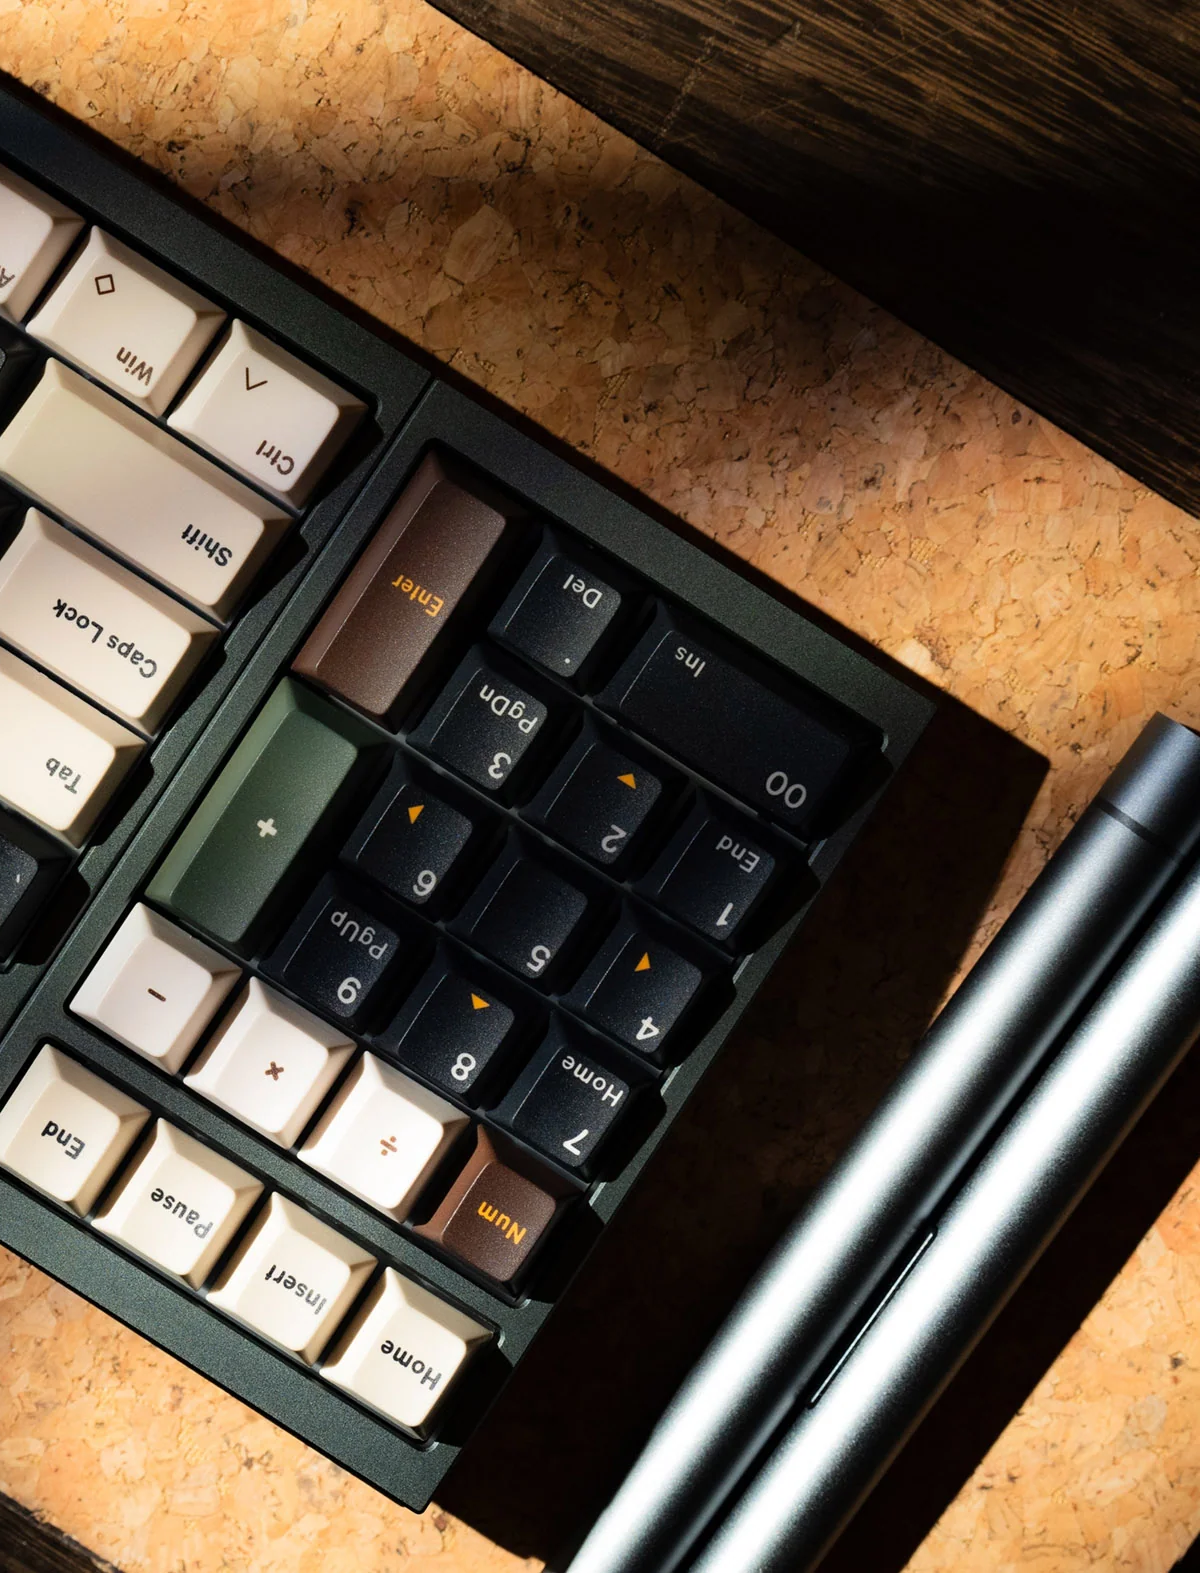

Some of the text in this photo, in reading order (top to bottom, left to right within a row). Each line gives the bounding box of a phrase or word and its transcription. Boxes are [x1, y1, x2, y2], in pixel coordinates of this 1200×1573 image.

[117, 347, 153, 385] Win
[256, 440, 294, 475] Ctrl
[182, 524, 232, 566] Shift
[392, 573, 444, 618] Enter
[563, 575, 602, 608] Del
[53, 599, 157, 678] Caps Lock
[675, 647, 705, 677] Ins
[480, 685, 538, 733] PgDn
[46, 758, 81, 794] Tab
[489, 753, 511, 779] 3
[766, 771, 806, 808] 00
[602, 825, 626, 853] 2
[716, 836, 760, 873] End
[413, 870, 436, 896] 6
[716, 903, 733, 926] 1
[331, 912, 388, 960] PgUp
[527, 946, 550, 972] 5
[338, 977, 361, 1004] 9
[636, 1017, 659, 1040] 4
[451, 1053, 476, 1080] 8
[563, 1056, 623, 1107] Home
[41, 1121, 84, 1159] End
[563, 1129, 588, 1155] 7
[150, 1188, 214, 1239] Pause
[478, 1202, 527, 1245] Num
[264, 1265, 327, 1314] Insert
[381, 1340, 441, 1389] Home
